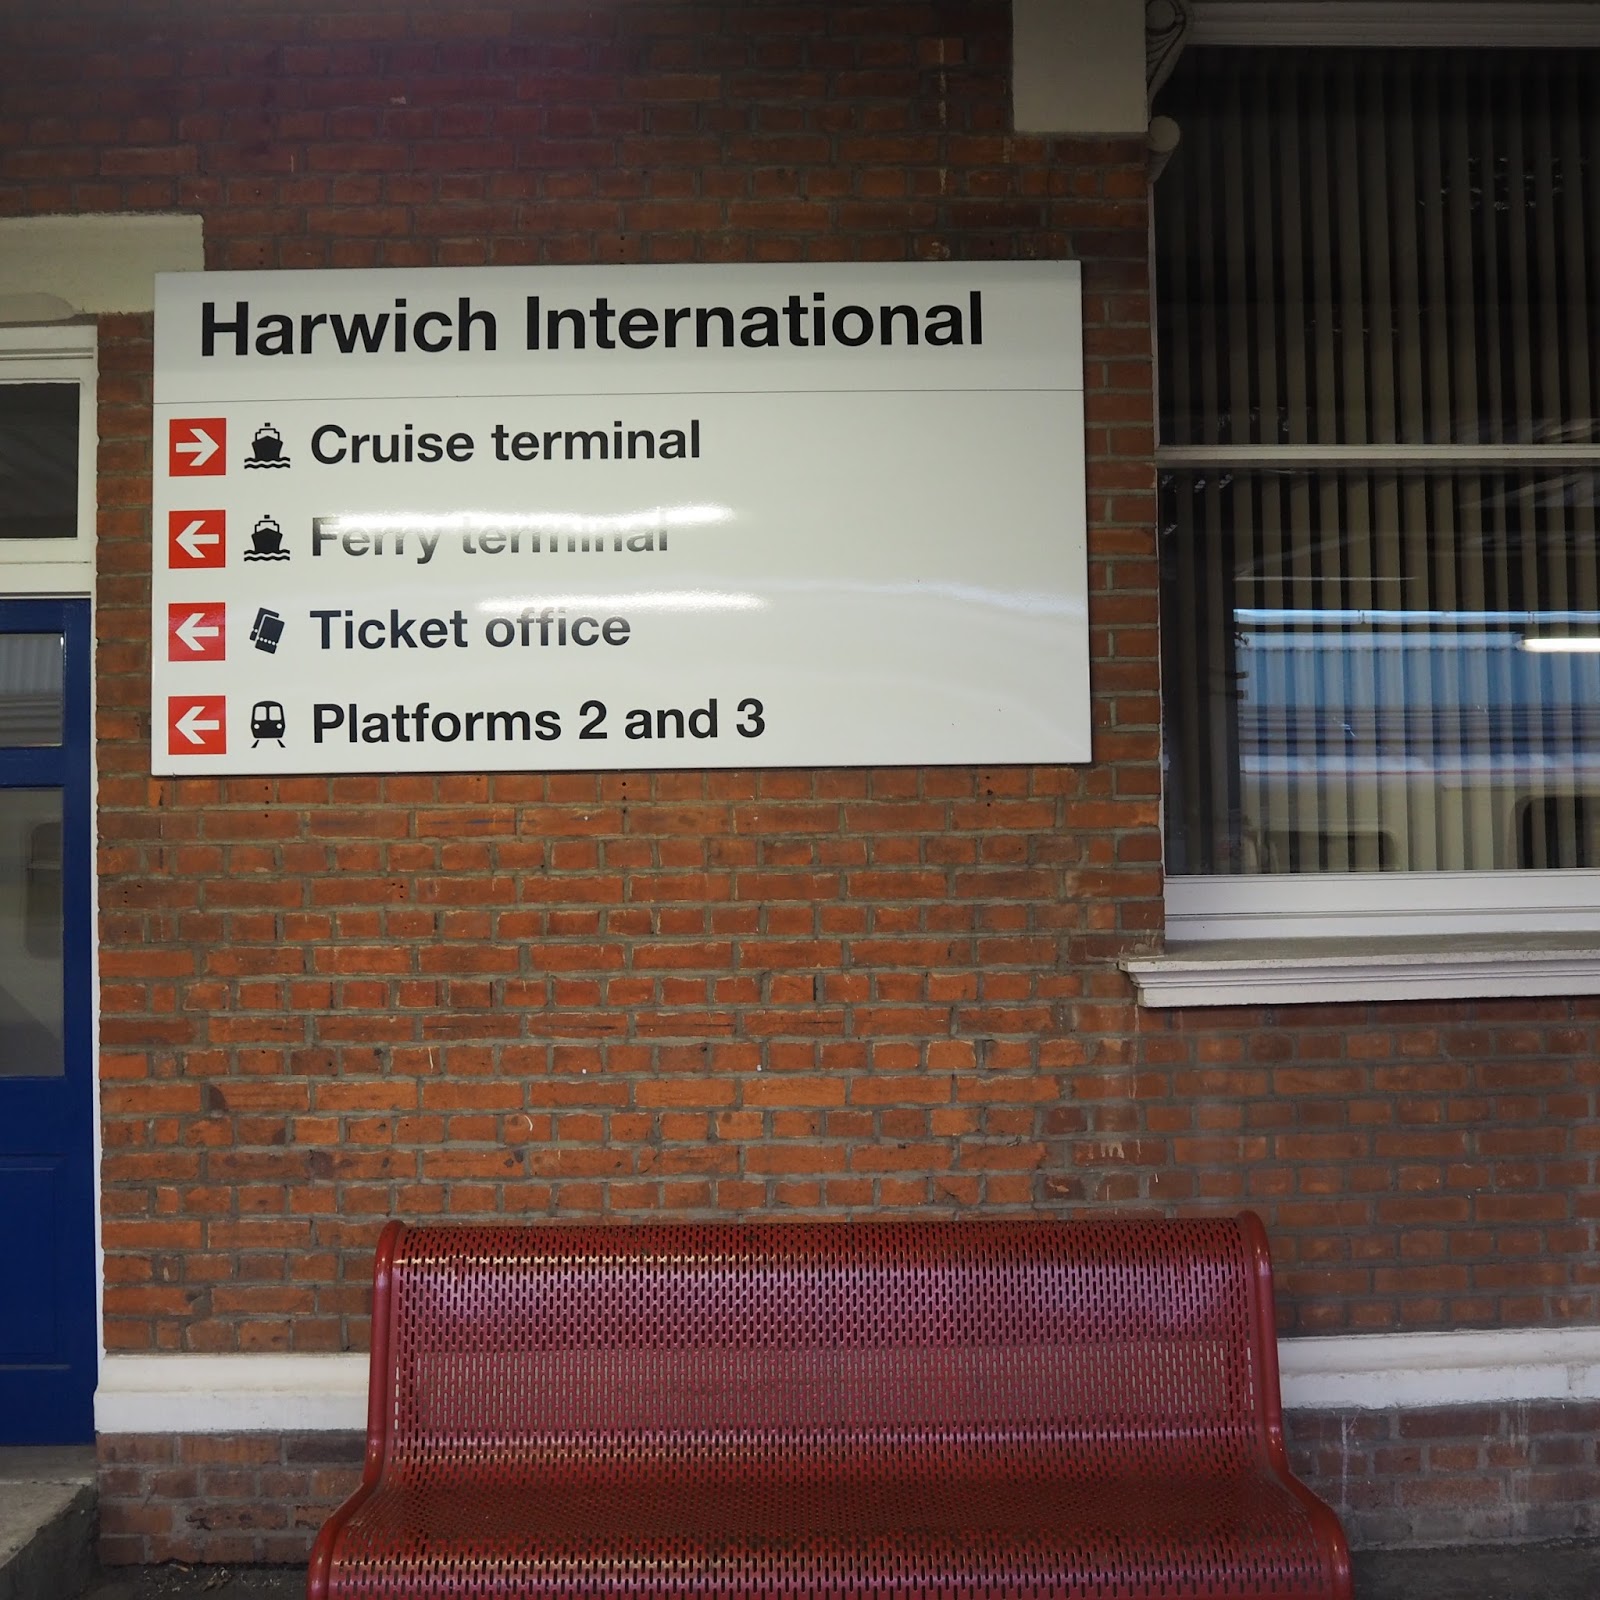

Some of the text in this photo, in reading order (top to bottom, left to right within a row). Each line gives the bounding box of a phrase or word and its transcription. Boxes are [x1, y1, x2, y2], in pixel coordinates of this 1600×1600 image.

[201, 290, 983, 357] Harwich International
[310, 419, 700, 465] Cruise terminal
[311, 512, 669, 565] Ferry terminal
[309, 607, 632, 650] Ticket office
[313, 698, 766, 744] Platforms 2 and 3
